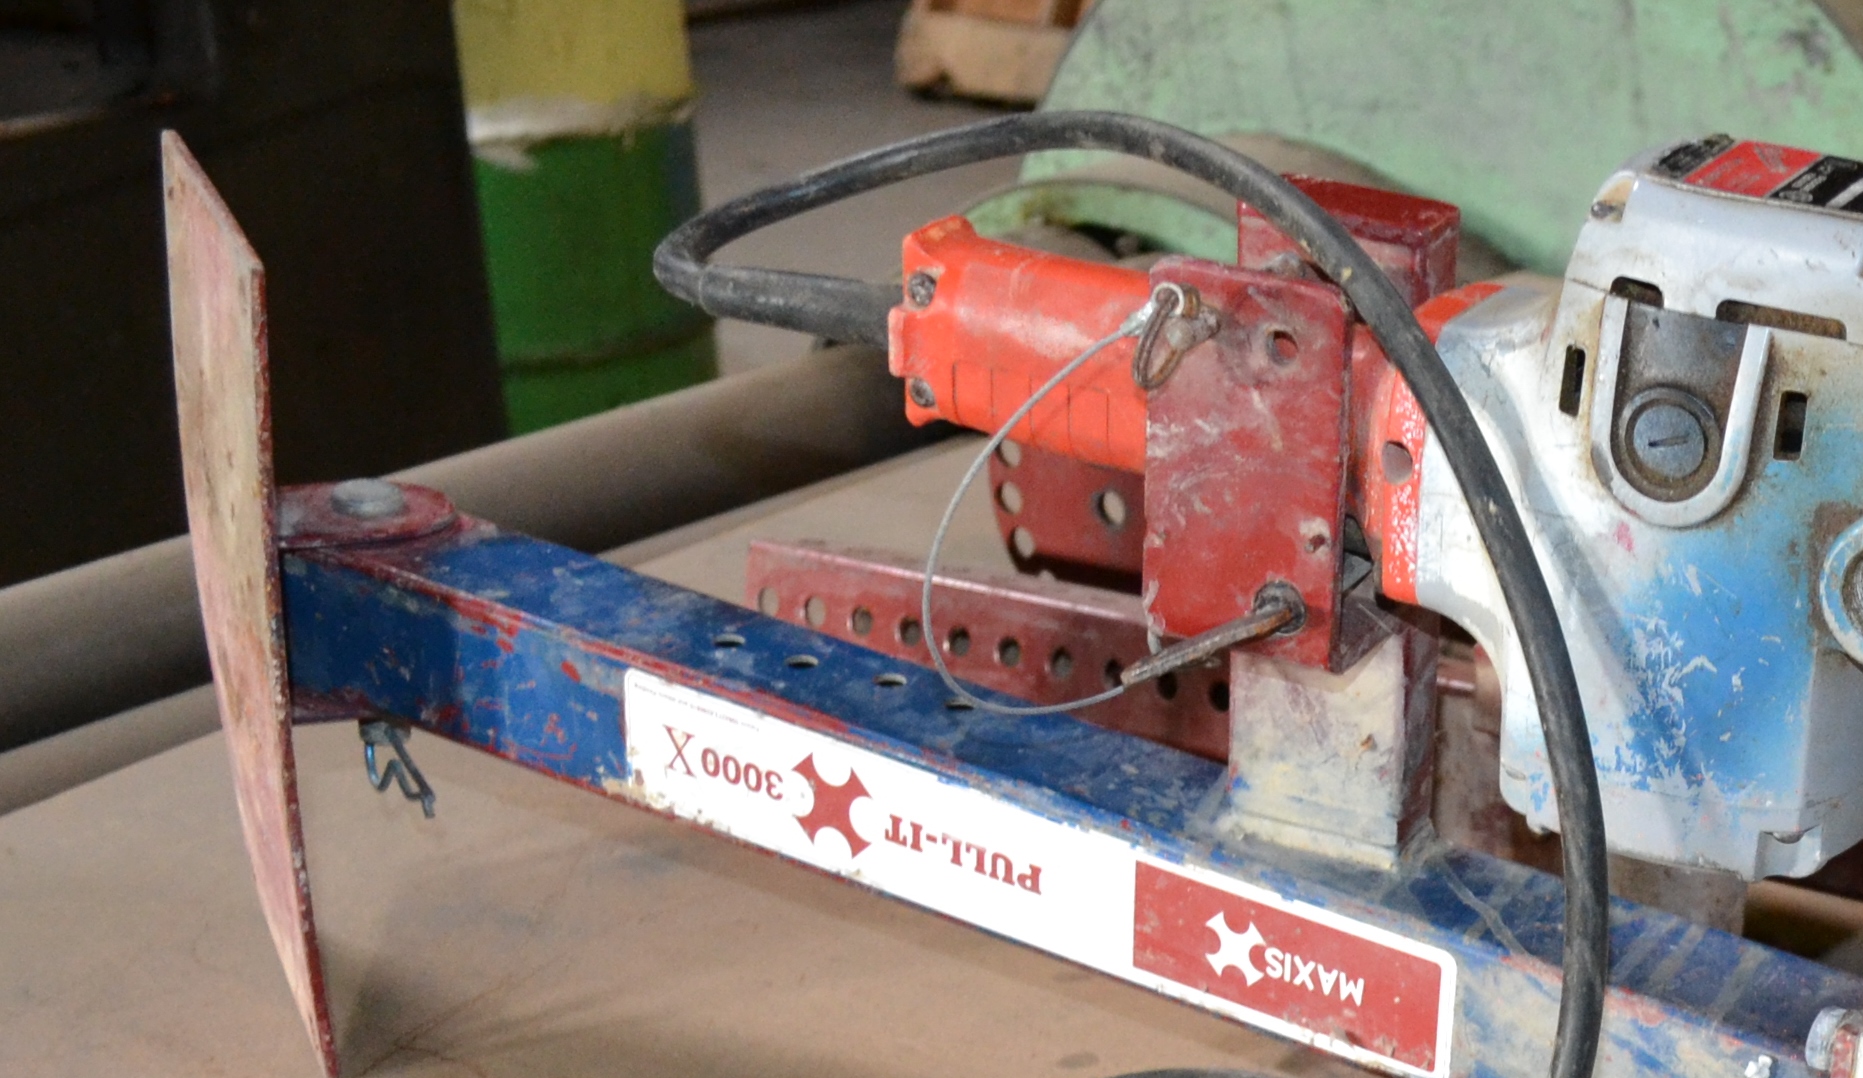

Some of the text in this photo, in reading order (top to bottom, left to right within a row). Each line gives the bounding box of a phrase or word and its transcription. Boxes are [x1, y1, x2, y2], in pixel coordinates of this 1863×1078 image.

[663, 724, 1042, 895] PULL-IT 3000 X
[1264, 946, 1365, 1007] MAXIS
